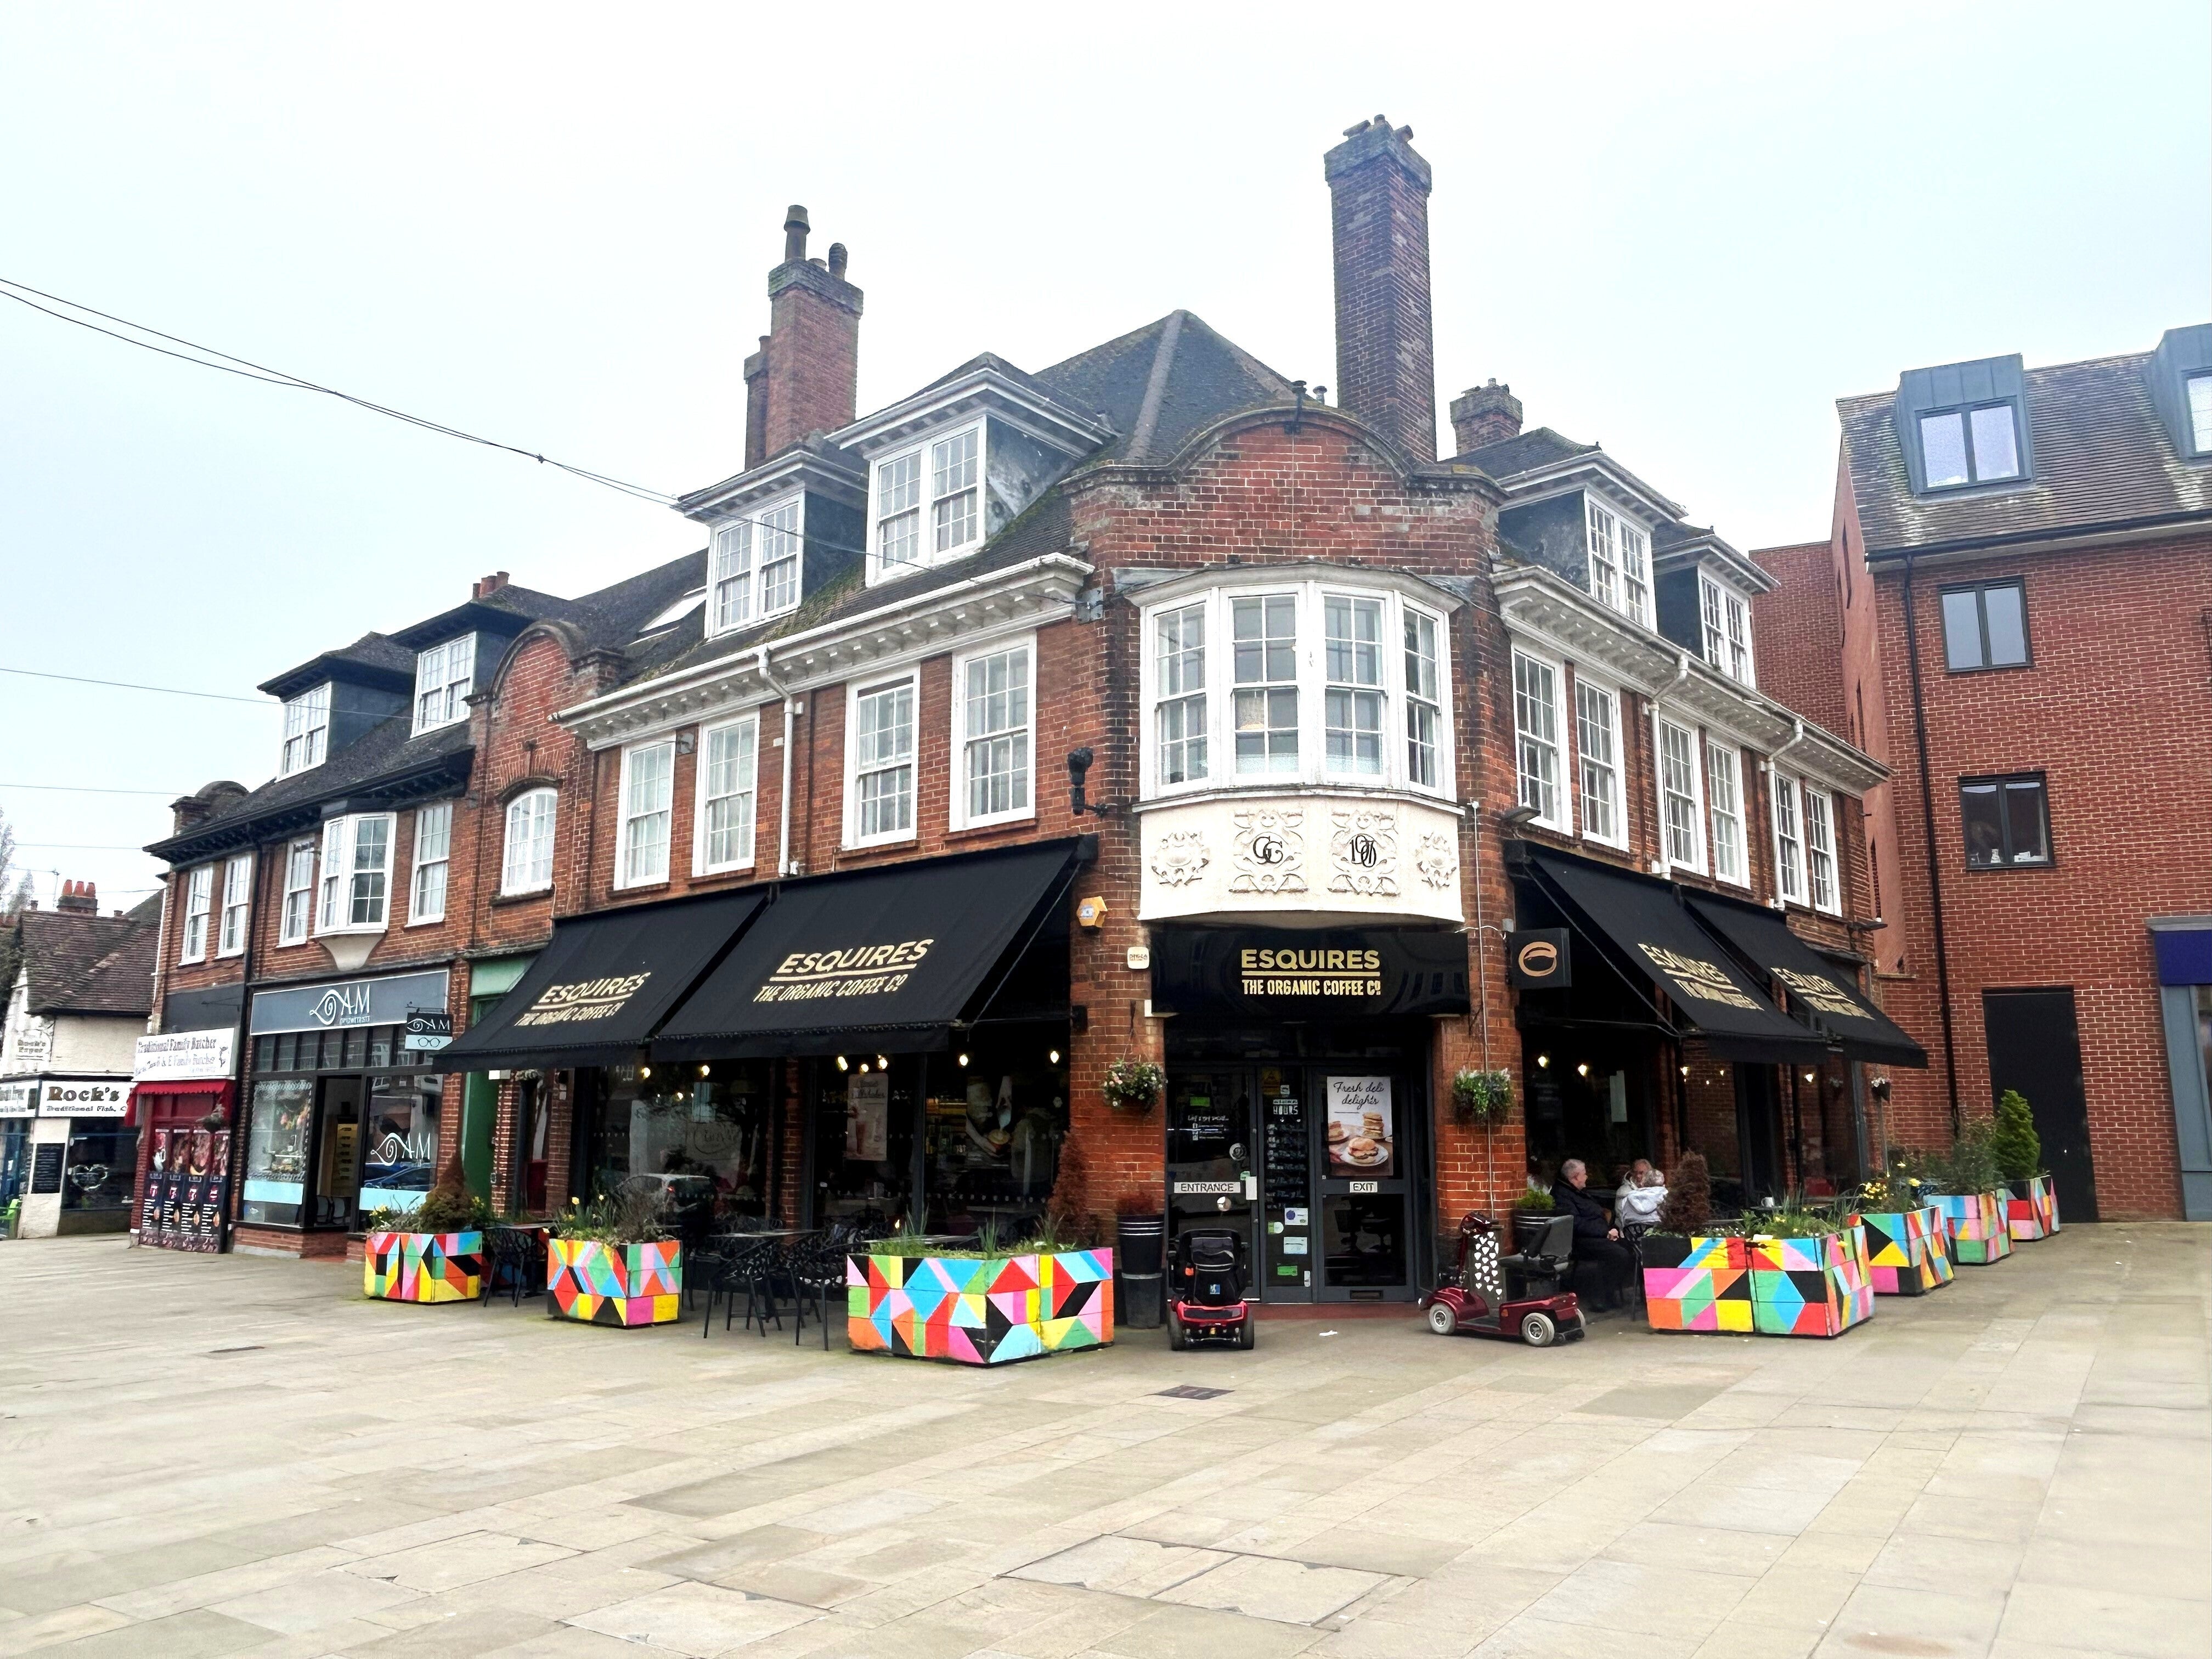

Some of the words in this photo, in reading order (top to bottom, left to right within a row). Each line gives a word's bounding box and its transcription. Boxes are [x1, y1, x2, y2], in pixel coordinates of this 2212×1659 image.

[776, 939, 934, 974] ESQUIRES
[1242, 949, 1380, 969] ESQUIRES
[538, 972, 651, 1003] ESQUIRES
[753, 986, 785, 1002] THE
[778, 980, 840, 1001] ORGANIC
[836, 976, 889, 997] COFFEE
[1242, 979, 1264, 995] THE
[1267, 979, 1320, 995] ORGANIC
[1323, 980, 1364, 996] COFFEE
[47, 1086, 120, 1101] Rock's
[1334, 1082, 1363, 1093] Fresh
[1365, 1082, 1384, 1092] deli
[1342, 1094, 1379, 1110] delights
[1181, 1183, 1233, 1192] ENTRANCE
[1353, 1183, 1374, 1191] EXIT
